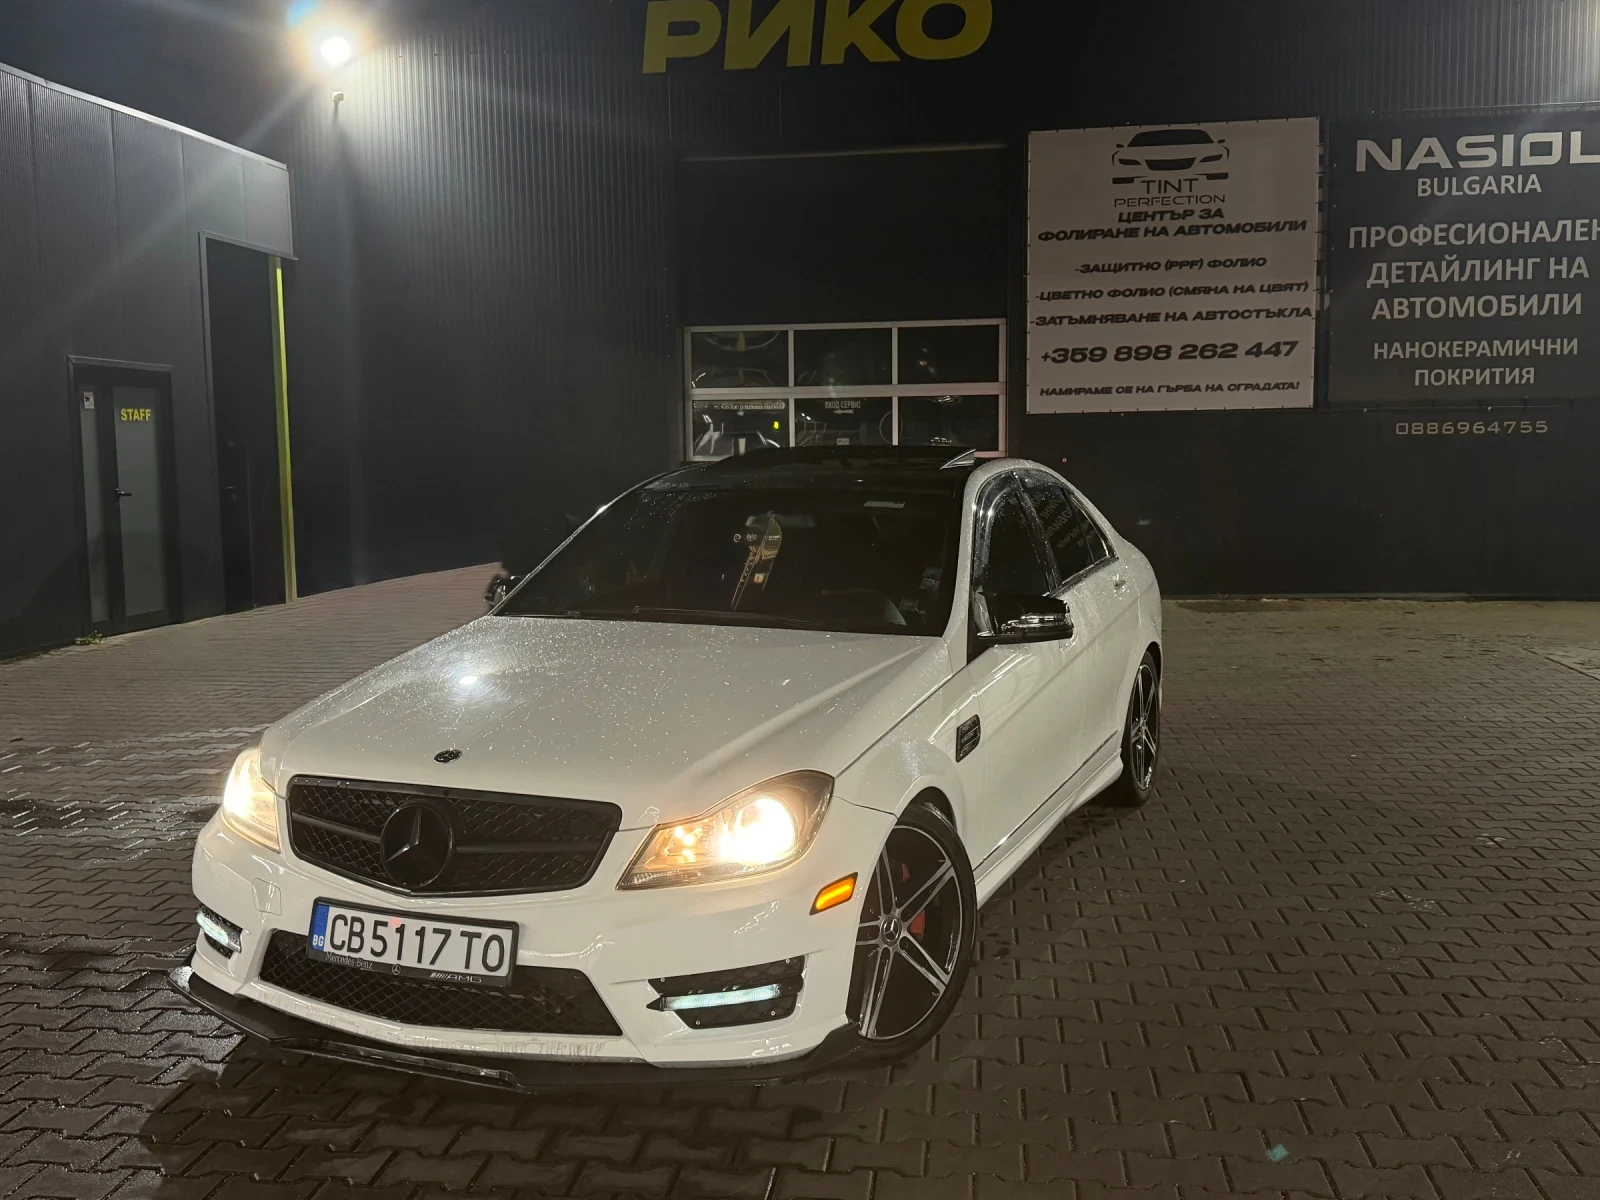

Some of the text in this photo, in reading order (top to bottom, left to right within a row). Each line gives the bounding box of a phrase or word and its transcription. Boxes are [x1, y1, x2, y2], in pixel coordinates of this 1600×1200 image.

[643, 0, 993, 74] РИКО
[1356, 131, 1600, 172] NASIOL
[1141, 178, 1198, 194] TINT
[1417, 174, 1542, 197] BULGARIA
[1114, 195, 1226, 208] PERFECTION
[1118, 208, 1224, 223] ЦЕНТЪР ЗА
[1038, 220, 1308, 242] ФОЛИРАНЕ НА АВТОМОБИЛИ
[1165, 258, 1203, 271] (PPF)
[1207, 257, 1267, 269] ФОЛИО
[1366, 254, 1589, 289] ДЕТАЙЛИНГ НА
[1107, 287, 1166, 299] ФОЛИО
[1169, 285, 1229, 298] (СМЯНА
[1233, 284, 1256, 294] НА
[1258, 281, 1309, 294] ЦВЯТ)
[1164, 311, 1189, 322] НА
[1192, 307, 1312, 321] АВТОСТЪКЛА
[1371, 293, 1582, 320] АВТОМОБИЛИ
[1041, 341, 1299, 363] +359 898 262 447
[1373, 338, 1578, 359] НАНОКЕРАМИЧНИ
[1414, 367, 1535, 386] ПОКРИТИЯ
[1040, 381, 1300, 396] НАМИРАМЕ СЕ НА ГЪРБА НА СГРАДАТА!
[120, 408, 151, 421] STAFF
[1396, 421, 1548, 435] 0886964755
[312, 934, 325, 947] BG
[325, 951, 373, 970] Mercedes-Benz
